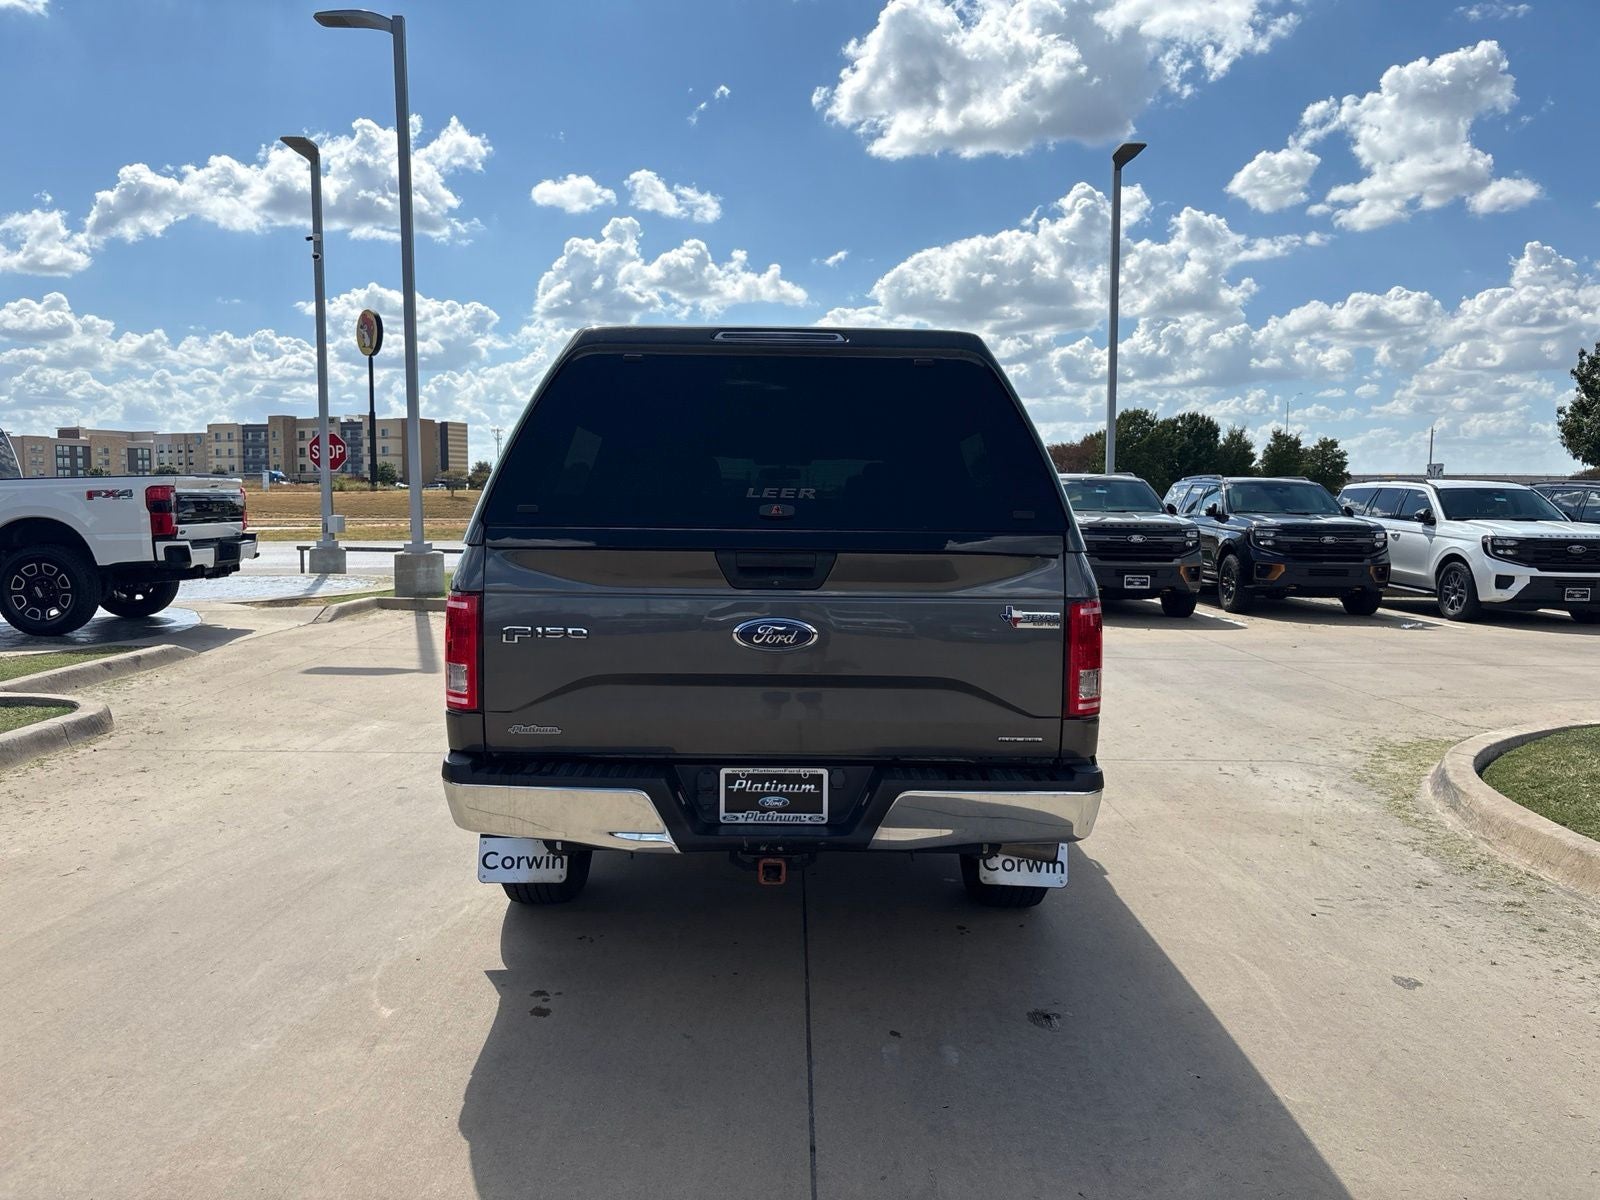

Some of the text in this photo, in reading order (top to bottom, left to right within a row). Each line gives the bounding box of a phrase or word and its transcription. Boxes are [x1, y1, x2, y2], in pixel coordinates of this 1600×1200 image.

[311, 444, 344, 459] SOP
[86, 489, 134, 501] FX4
[745, 487, 816, 499] LEER
[1024, 614, 1060, 623] TEXAS
[752, 624, 799, 644] Ford
[507, 724, 562, 734] Platinum
[727, 780, 820, 793] Platinum
[764, 798, 784, 806] Ford
[744, 811, 807, 822] Platinum
[481, 851, 565, 870] Corwin
[982, 854, 1066, 875] Corwin
